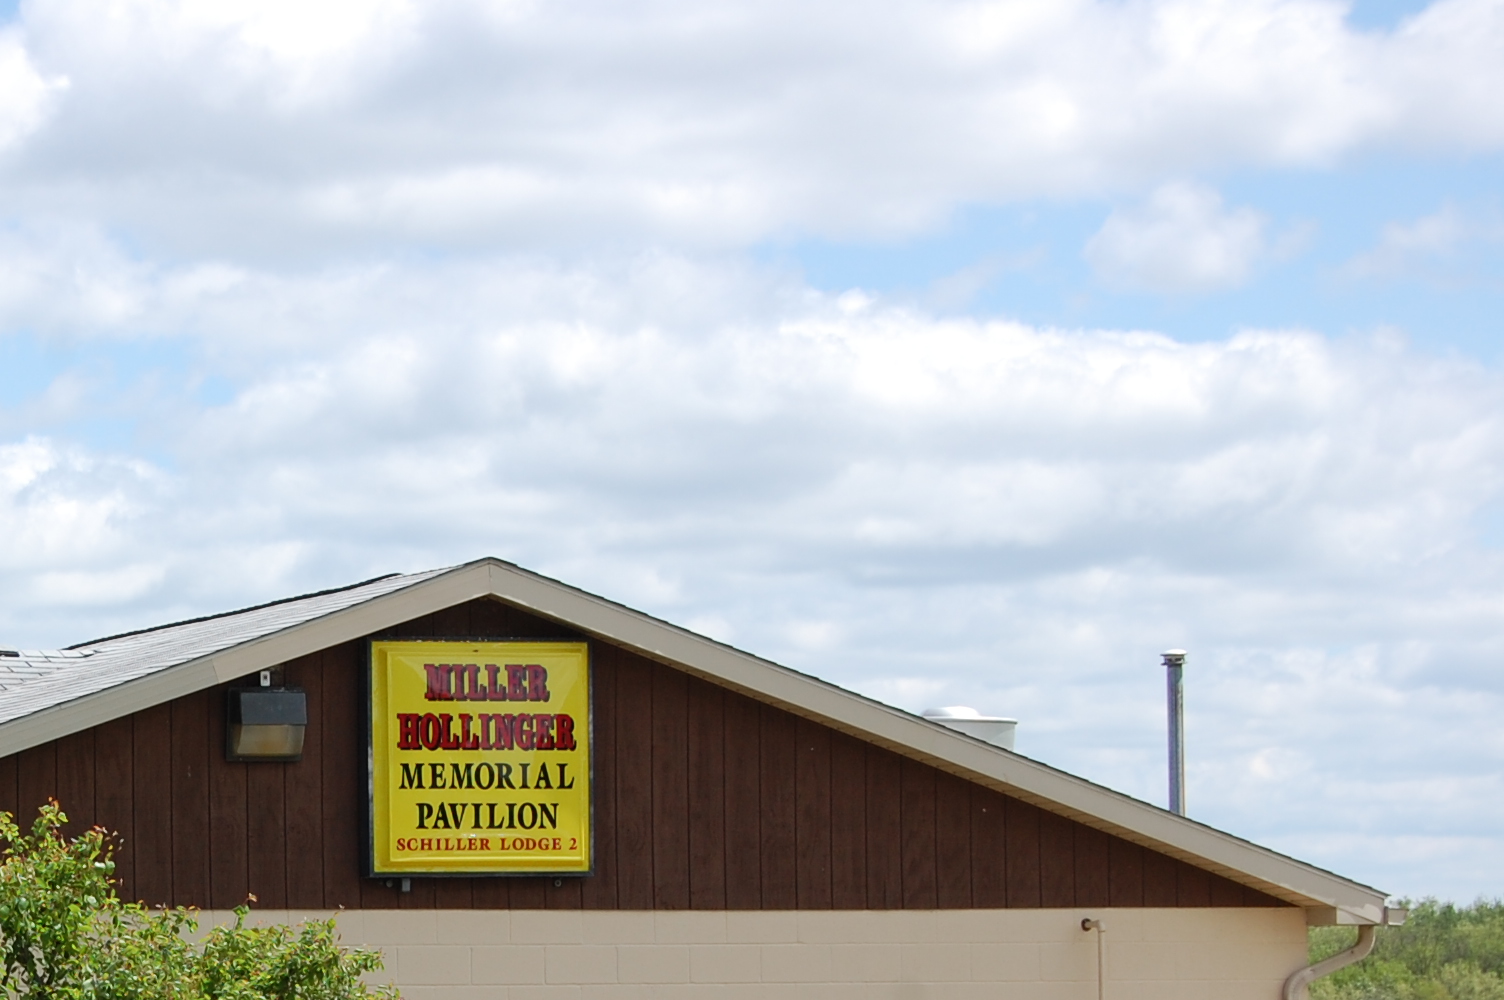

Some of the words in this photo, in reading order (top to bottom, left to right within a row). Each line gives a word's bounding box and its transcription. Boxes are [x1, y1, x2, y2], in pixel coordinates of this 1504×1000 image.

[423, 664, 550, 702] MILLER
[397, 713, 576, 750] HOLLINGER
[399, 762, 575, 789] MEMORIAL
[416, 802, 559, 829] PAVILION
[396, 837, 491, 851] SCHILLER
[500, 837, 562, 851] LODGE
[569, 837, 578, 850] 2
